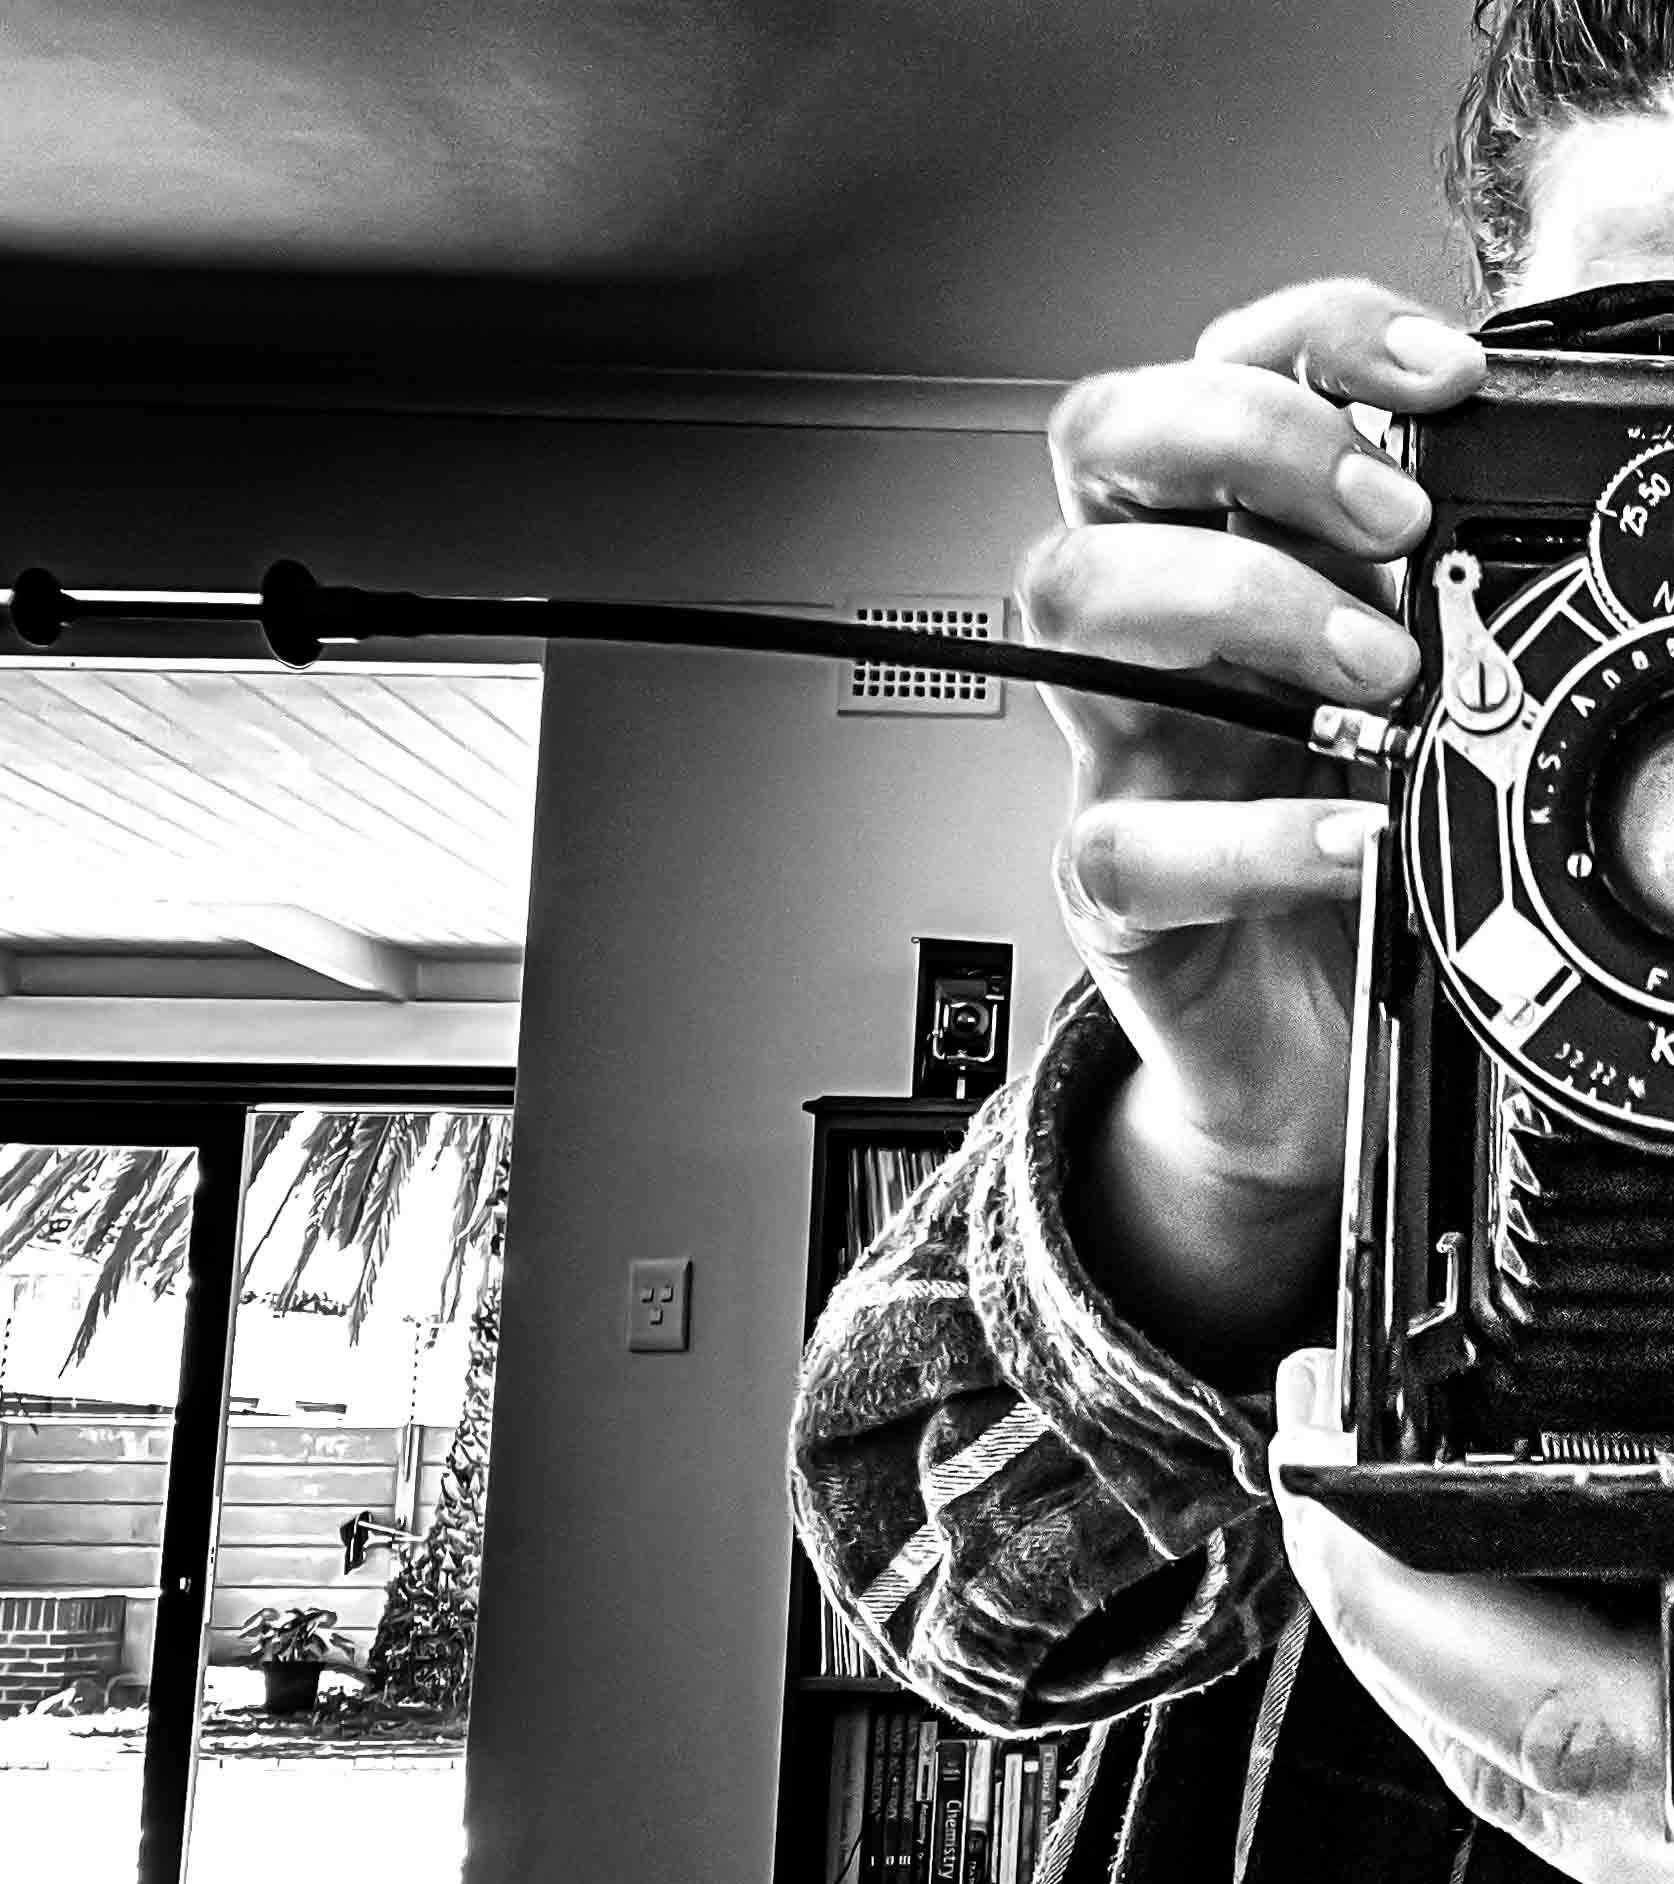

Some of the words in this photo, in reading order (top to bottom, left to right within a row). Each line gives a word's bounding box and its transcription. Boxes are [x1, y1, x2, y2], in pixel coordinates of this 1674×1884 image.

[1619, 504, 1648, 537] 25
[1638, 473, 1671, 506] 50
[1646, 967, 1670, 991] F
[938, 1799, 962, 1880] Chemistry
